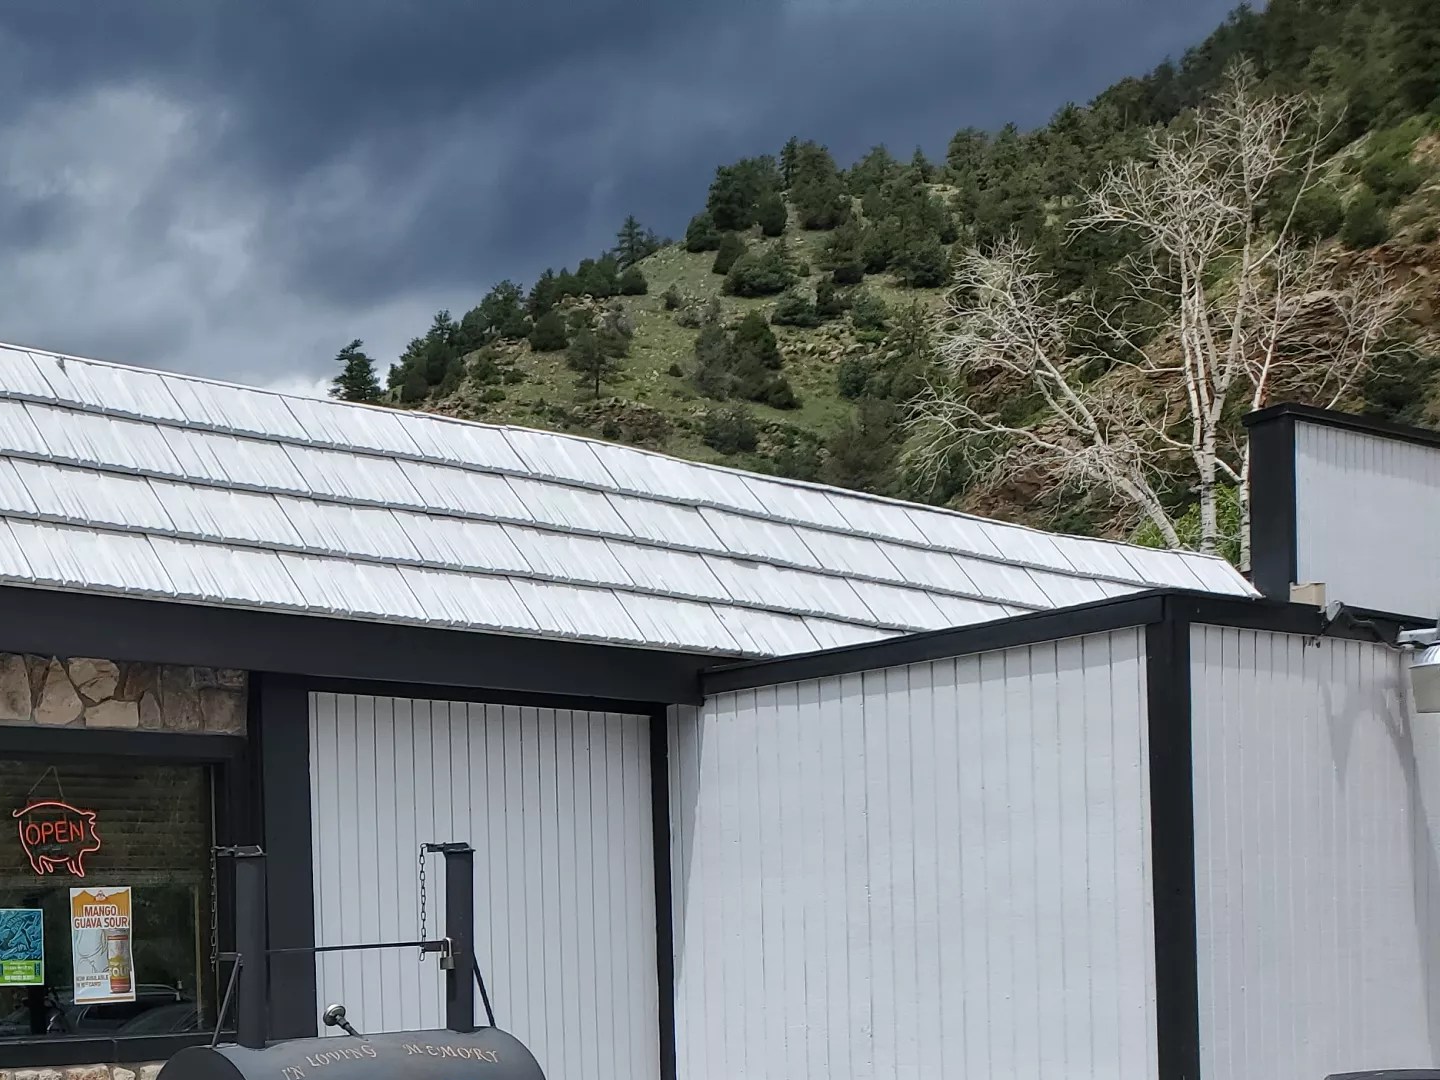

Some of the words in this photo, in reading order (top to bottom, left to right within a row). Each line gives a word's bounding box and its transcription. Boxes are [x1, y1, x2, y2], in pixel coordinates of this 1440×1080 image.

[25, 820, 84, 845] OPEN
[84, 905, 117, 917] MANGO
[74, 917, 102, 929] GUAVA
[104, 916, 128, 928] SOUR
[306, 1043, 377, 1068] LOVING
[401, 1043, 499, 1063] MEMORY
